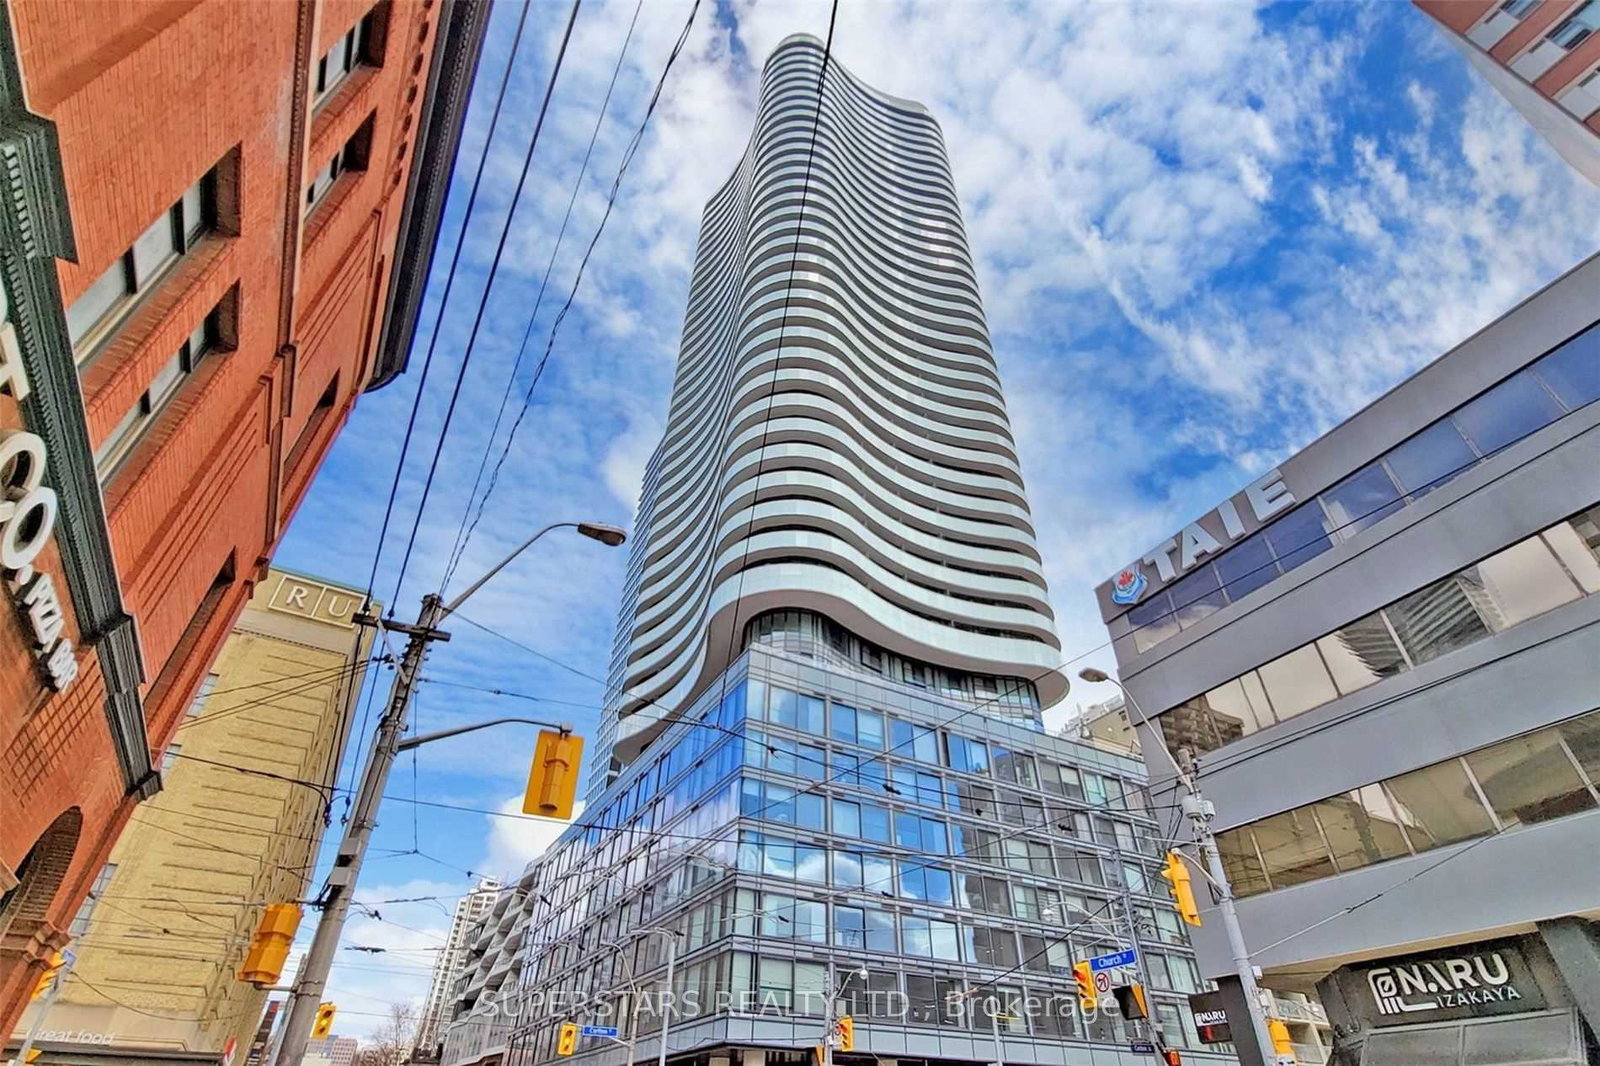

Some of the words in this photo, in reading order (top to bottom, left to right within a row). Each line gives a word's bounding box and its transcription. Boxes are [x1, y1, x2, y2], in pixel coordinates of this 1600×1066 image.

[1142, 469, 1297, 583] TAIE
[1098, 955, 1122, 968] Church
[1437, 986, 1521, 1008] IZAKAYA
[75, 1029, 115, 1044] food
